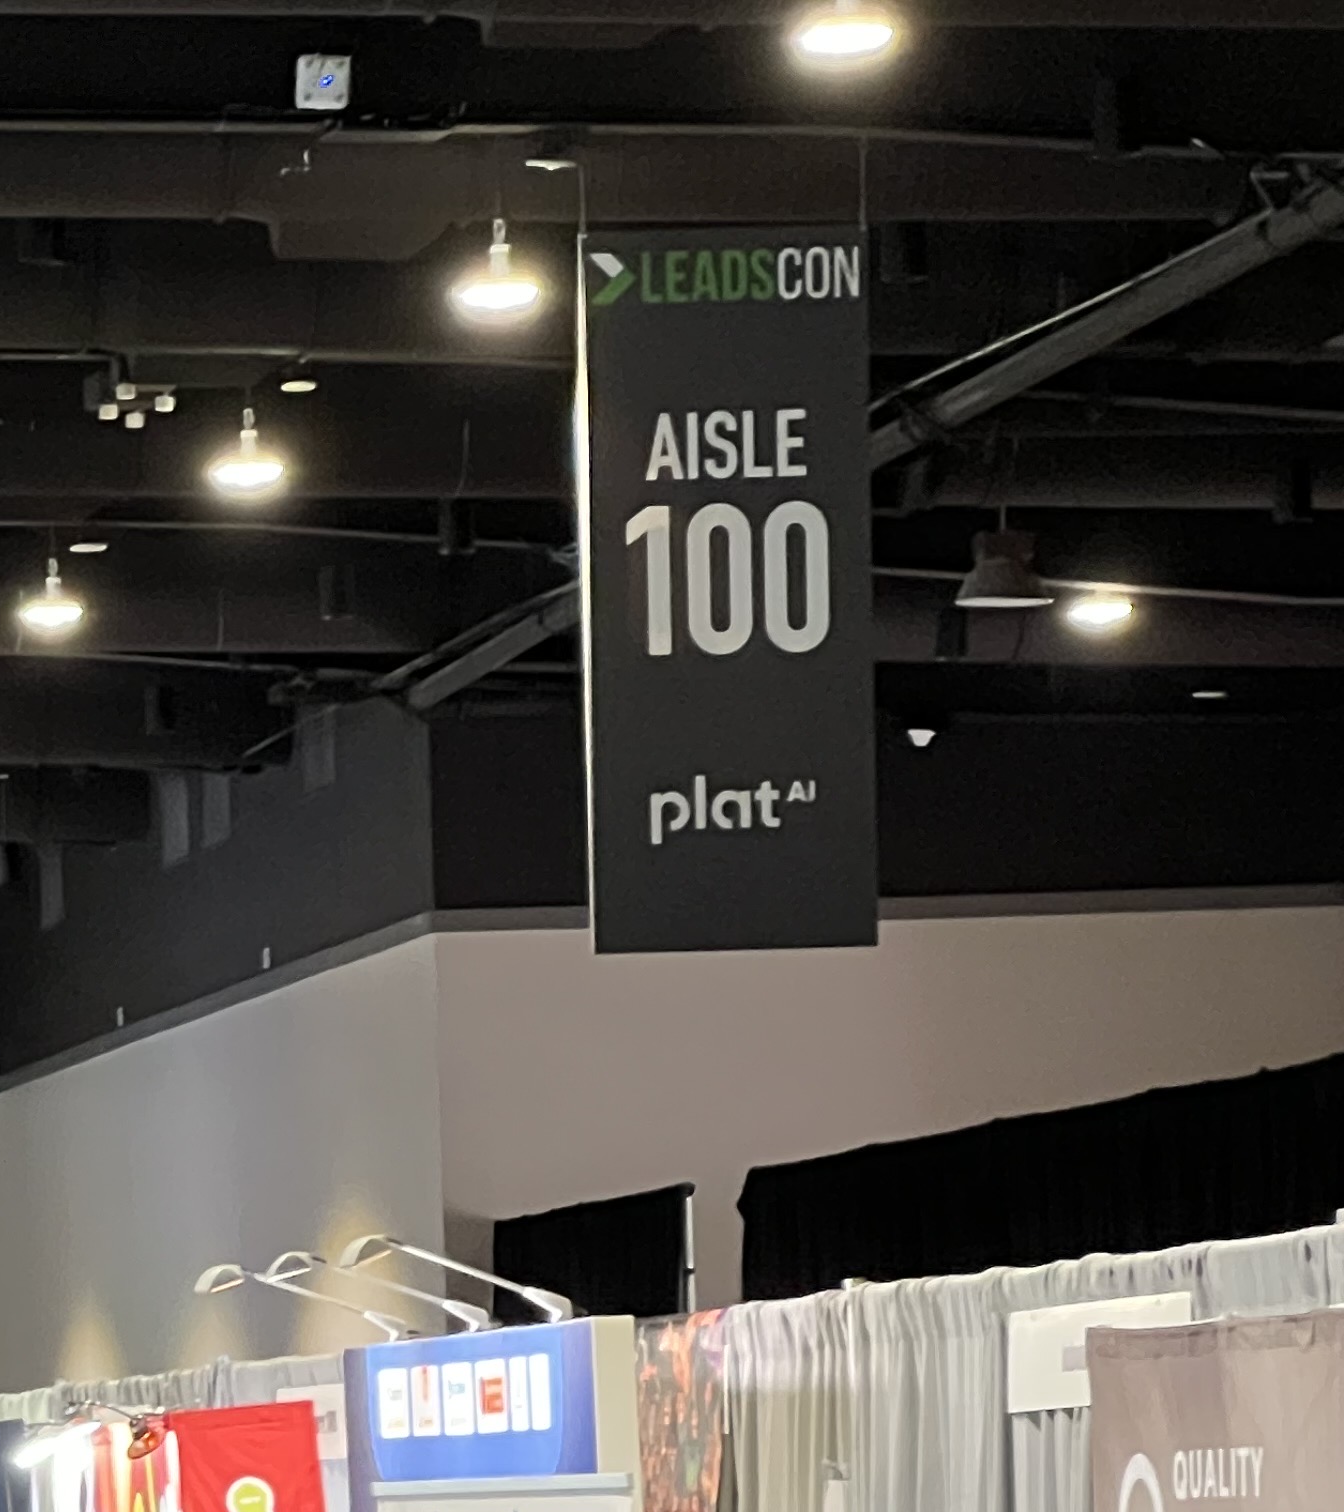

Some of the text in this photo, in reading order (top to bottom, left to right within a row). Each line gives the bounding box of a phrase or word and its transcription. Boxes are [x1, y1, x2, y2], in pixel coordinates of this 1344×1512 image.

[640, 246, 861, 304] LEADSCON
[645, 408, 808, 482] AISLE
[625, 500, 830, 657] 100
[1173, 1446, 1264, 1500] QUALITY
